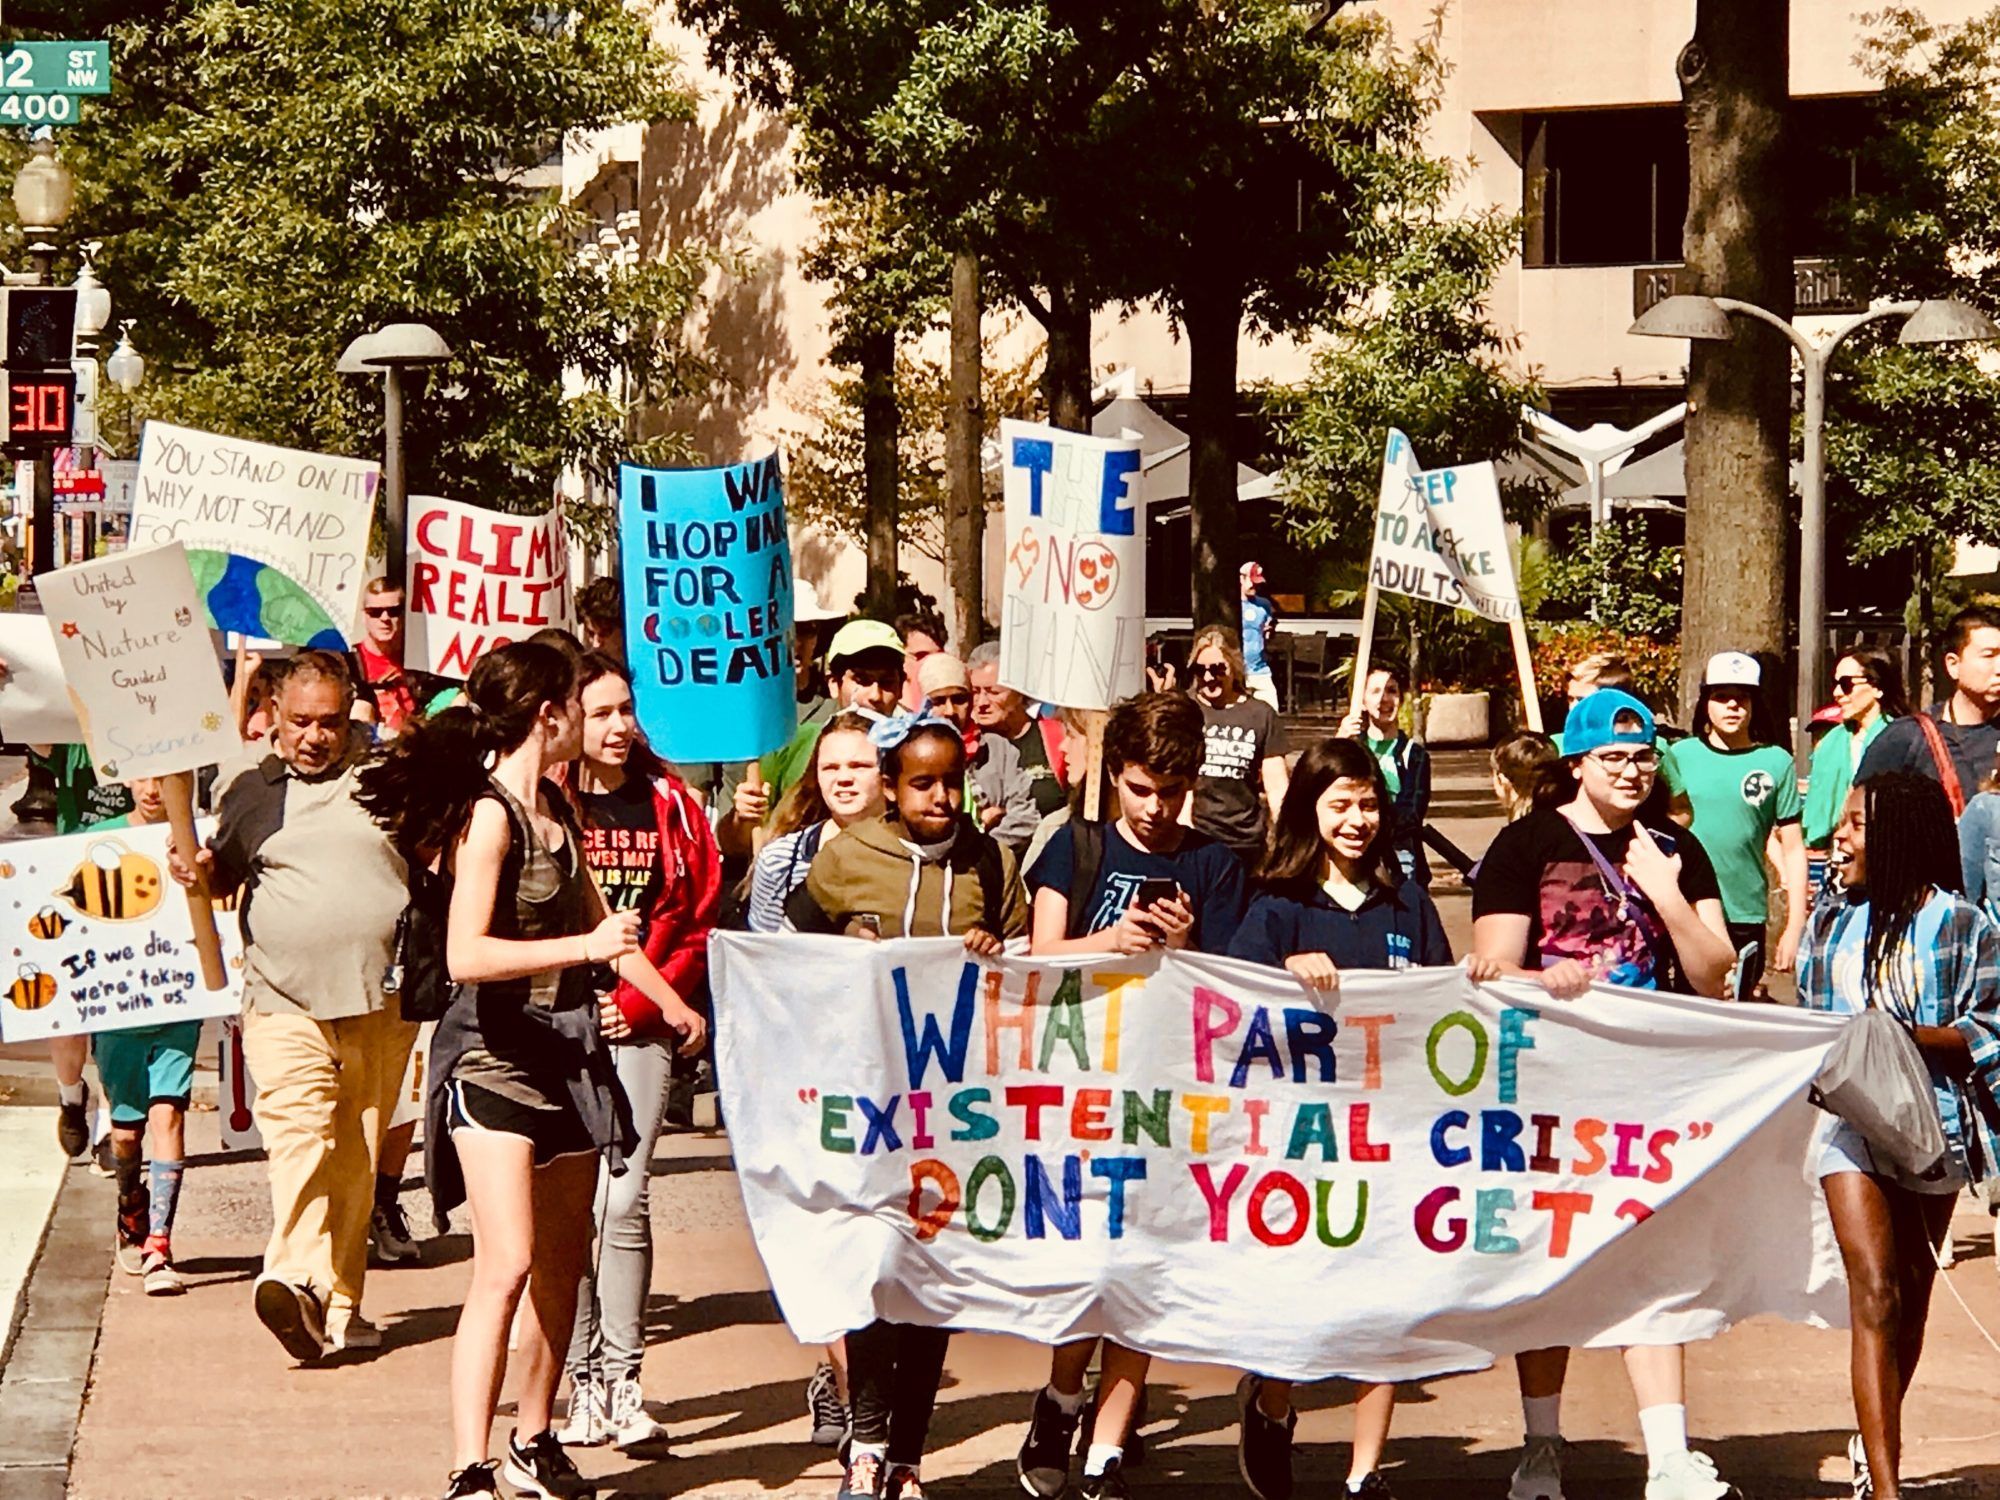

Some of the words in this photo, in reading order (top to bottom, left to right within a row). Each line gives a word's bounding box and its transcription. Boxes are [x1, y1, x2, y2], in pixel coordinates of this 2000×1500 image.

[67, 69, 98, 87] NW
[68, 50, 97, 69] ST
[12, 386, 65, 431] 30
[154, 435, 205, 477] YOU
[210, 447, 285, 483] STAND
[297, 464, 337, 492] ON
[1386, 433, 1406, 466] IF
[640, 474, 658, 513] I
[723, 451, 782, 513] WA
[1011, 436, 1142, 536] THE
[143, 475, 194, 510] WHY
[195, 493, 247, 525] NOT
[247, 500, 345, 542] STAND
[646, 506, 789, 560] HOPIN
[1379, 510, 1409, 546] TO
[1411, 520, 1444, 556] AC
[303, 552, 357, 592] IT?
[1008, 525, 1041, 590] IS
[73, 565, 137, 597] United
[410, 561, 572, 627] REALIT
[645, 564, 743, 608] FOR
[768, 552, 788, 600] A
[101, 596, 127, 615] by
[80, 627, 181, 661] Nature
[111, 664, 167, 690] Guided
[135, 691, 158, 715] by
[106, 725, 205, 764] Science
[611, 829, 631, 849] IS
[635, 830, 660, 850] RE
[622, 850, 656, 868] MAT
[60, 948, 97, 980] If
[104, 945, 135, 963] we
[144, 930, 180, 957] die,
[70, 979, 130, 1004] we're
[140, 967, 196, 990] taking
[77, 1004, 107, 1023] you
[116, 993, 154, 1013] with
[163, 988, 188, 1005] us.
[891, 961, 1147, 1090] WHAT
[1192, 985, 1397, 1090] PART
[1425, 1007, 1541, 1105] OF
[906, 1148, 1148, 1243] DON'T
[1188, 1162, 1369, 1249] YOU
